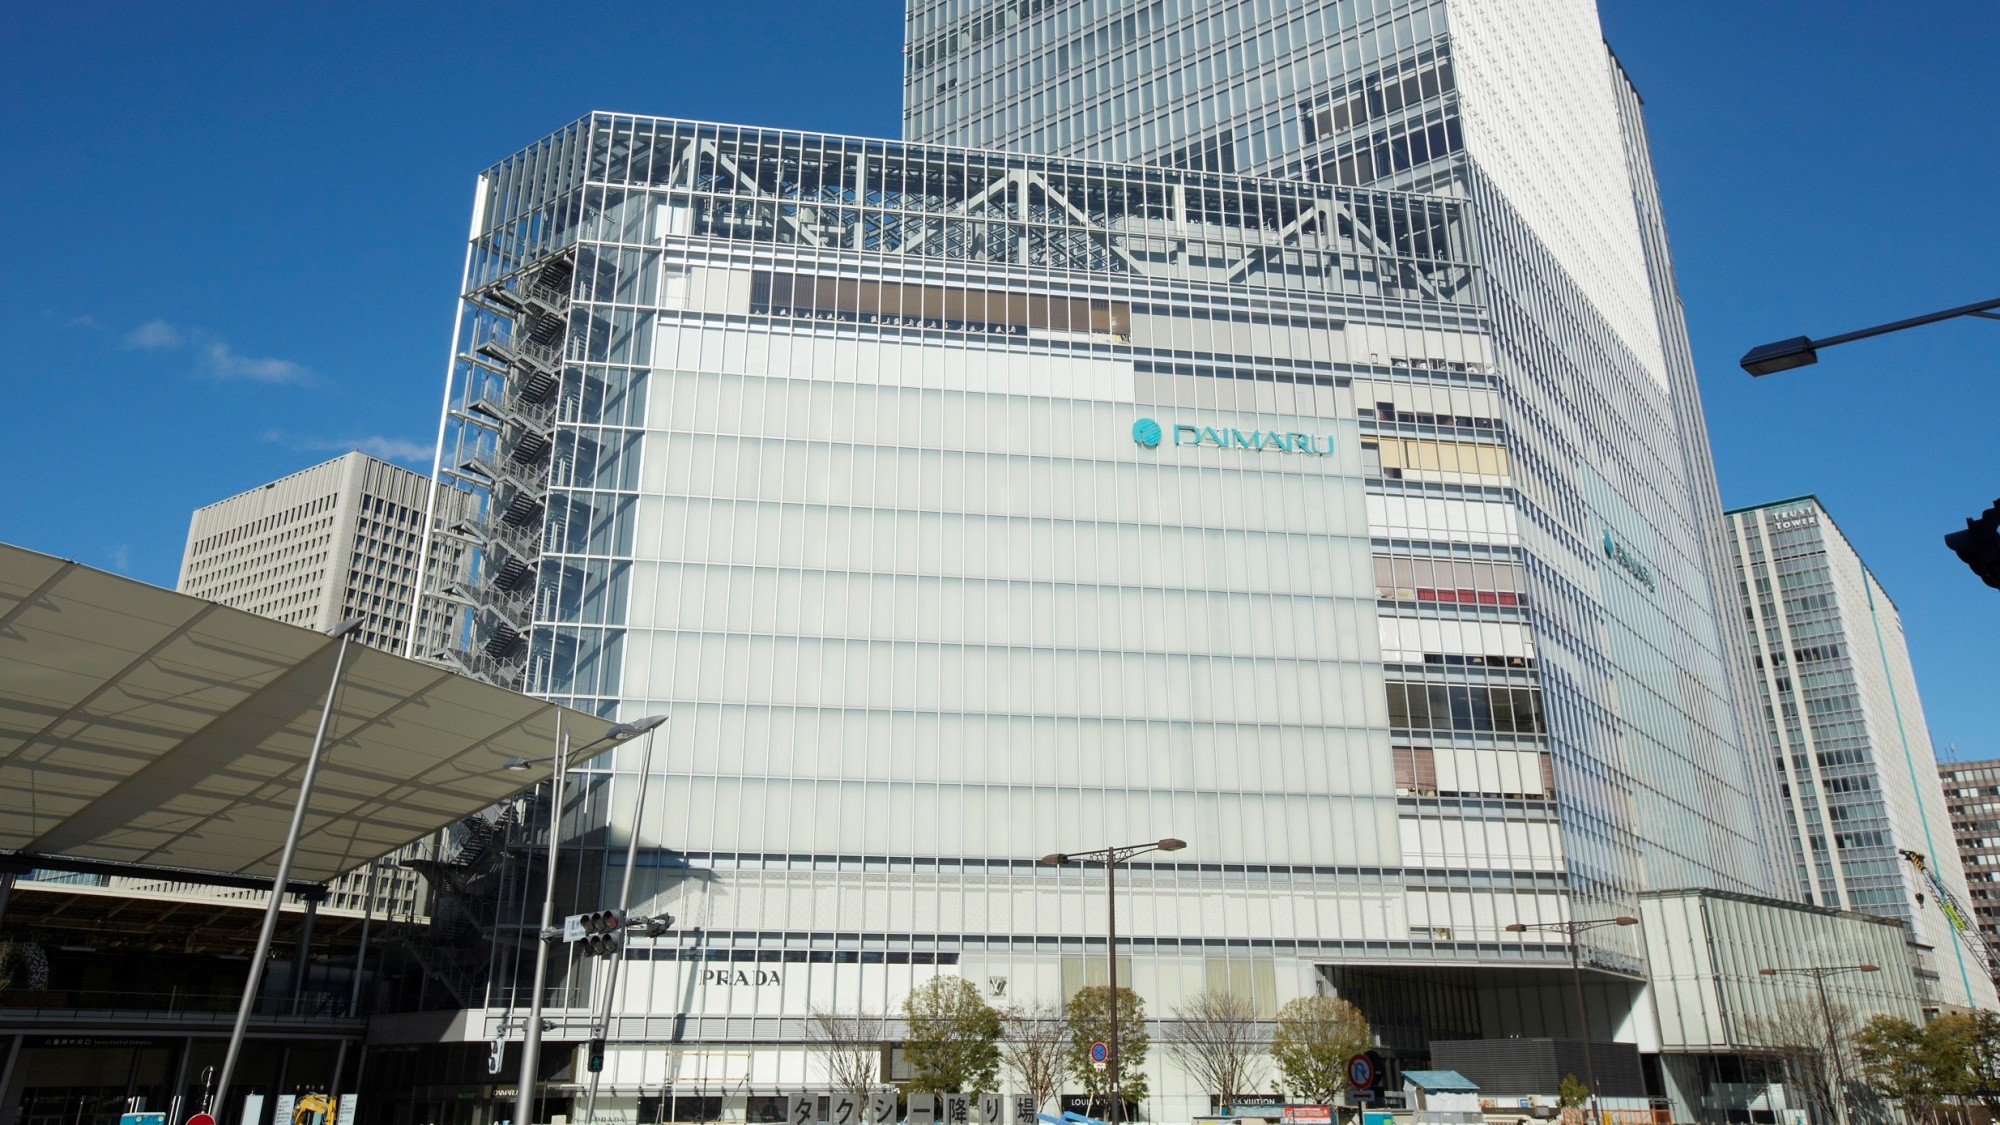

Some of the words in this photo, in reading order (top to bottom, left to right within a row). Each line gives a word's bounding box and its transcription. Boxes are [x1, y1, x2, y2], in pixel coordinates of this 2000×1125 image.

[1174, 424, 1334, 457] DAIMARU
[1773, 507, 1812, 520] TRUST
[1775, 516, 1815, 530] TOWER
[699, 970, 784, 986] PRADA
